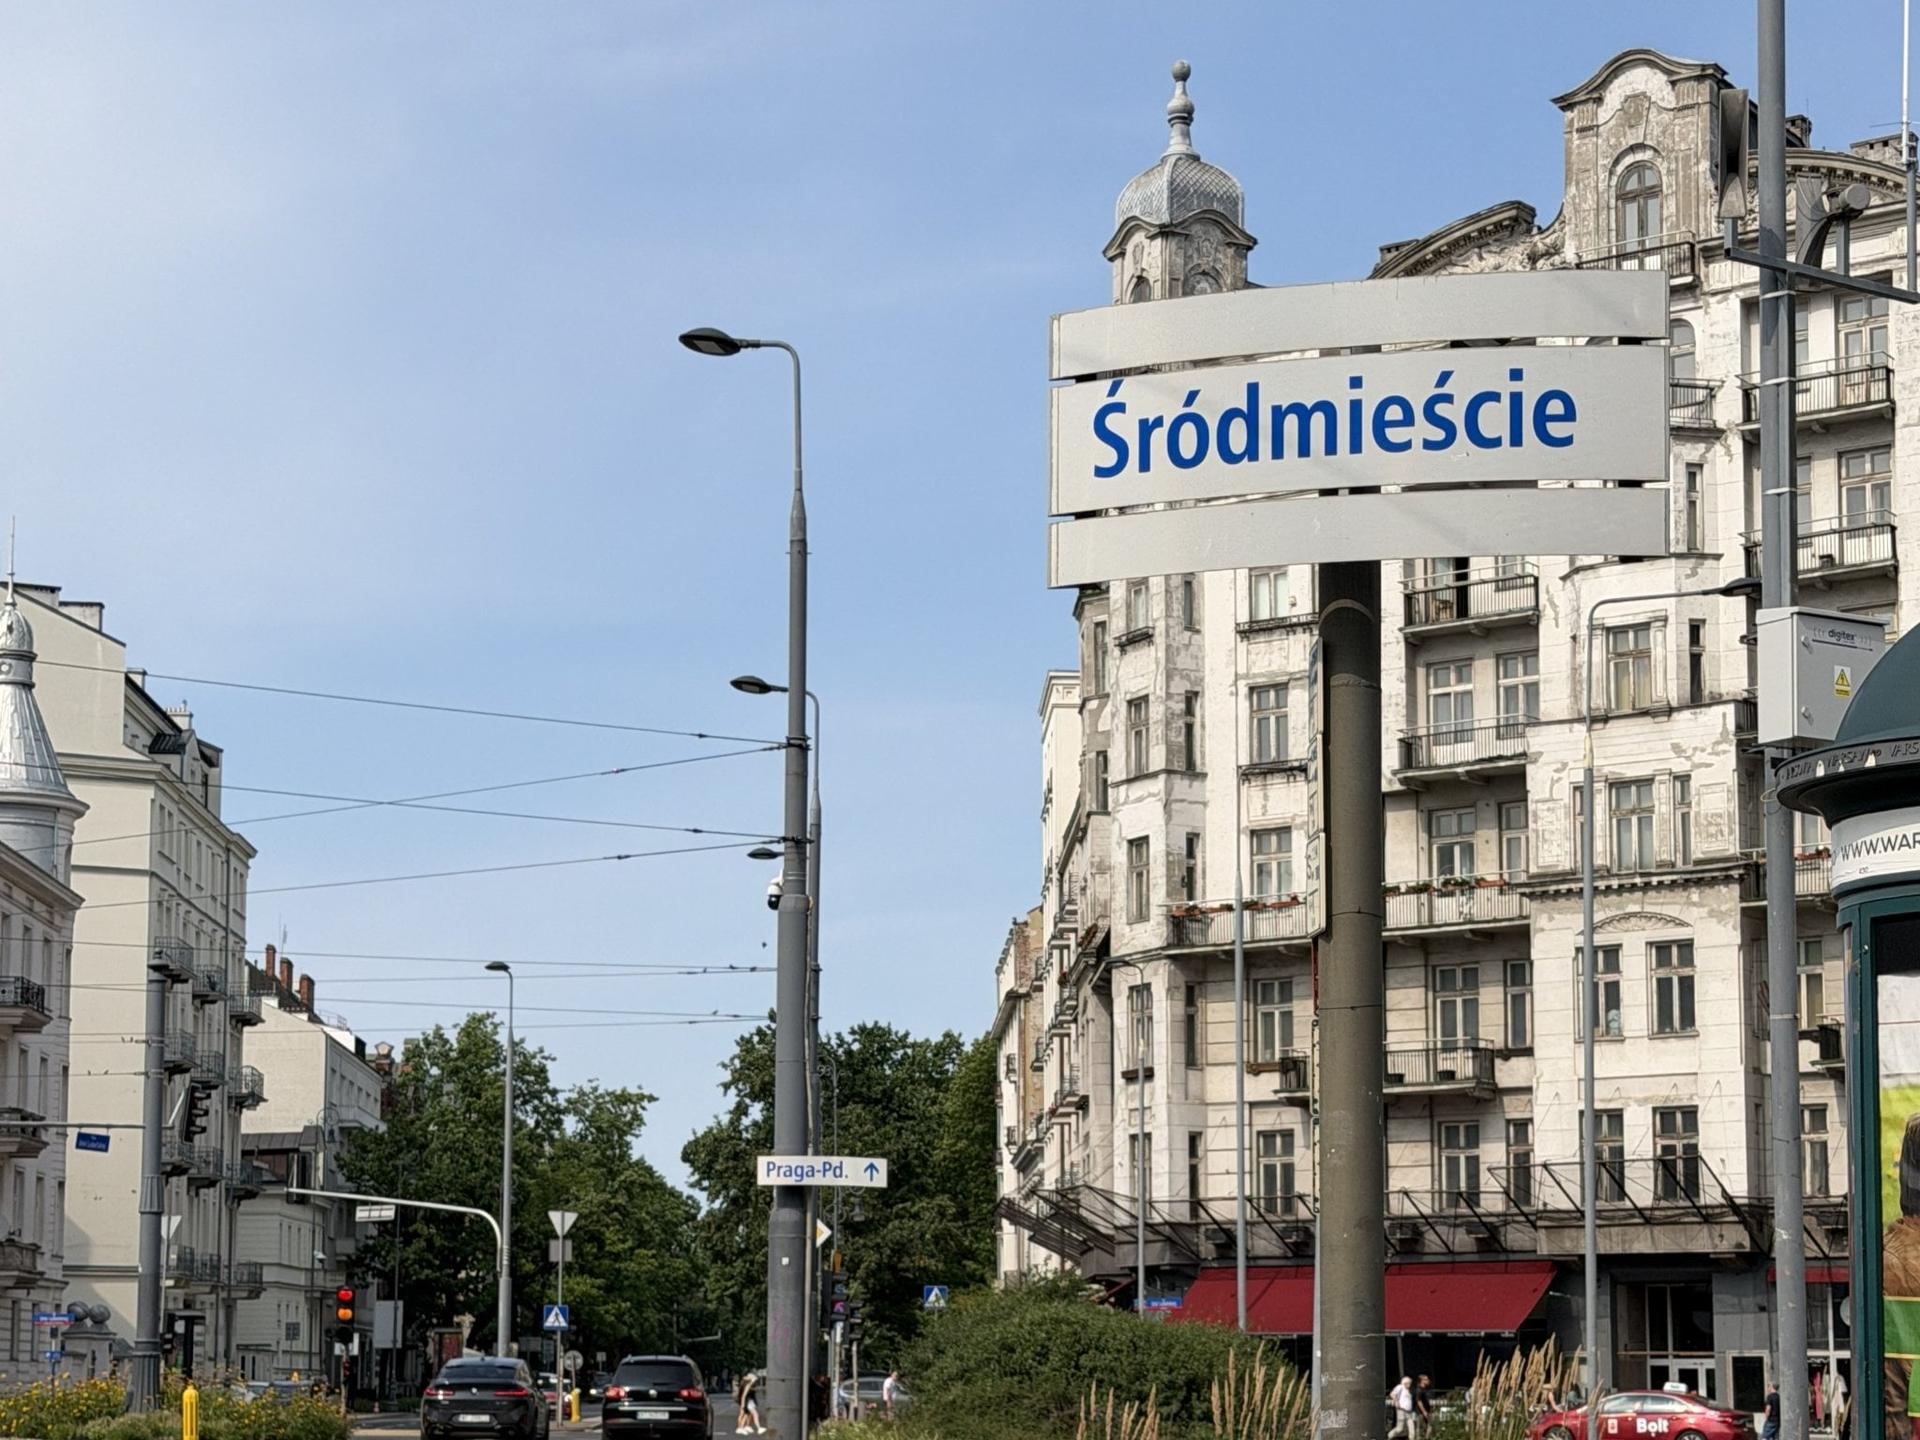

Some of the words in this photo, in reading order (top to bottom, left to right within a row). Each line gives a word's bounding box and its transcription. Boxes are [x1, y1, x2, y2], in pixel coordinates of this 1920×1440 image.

[1092, 367, 1577, 479] Śródmieście
[766, 1161, 848, 1182] Praga-Pd.
[1636, 1417, 1669, 1437] Bolt
